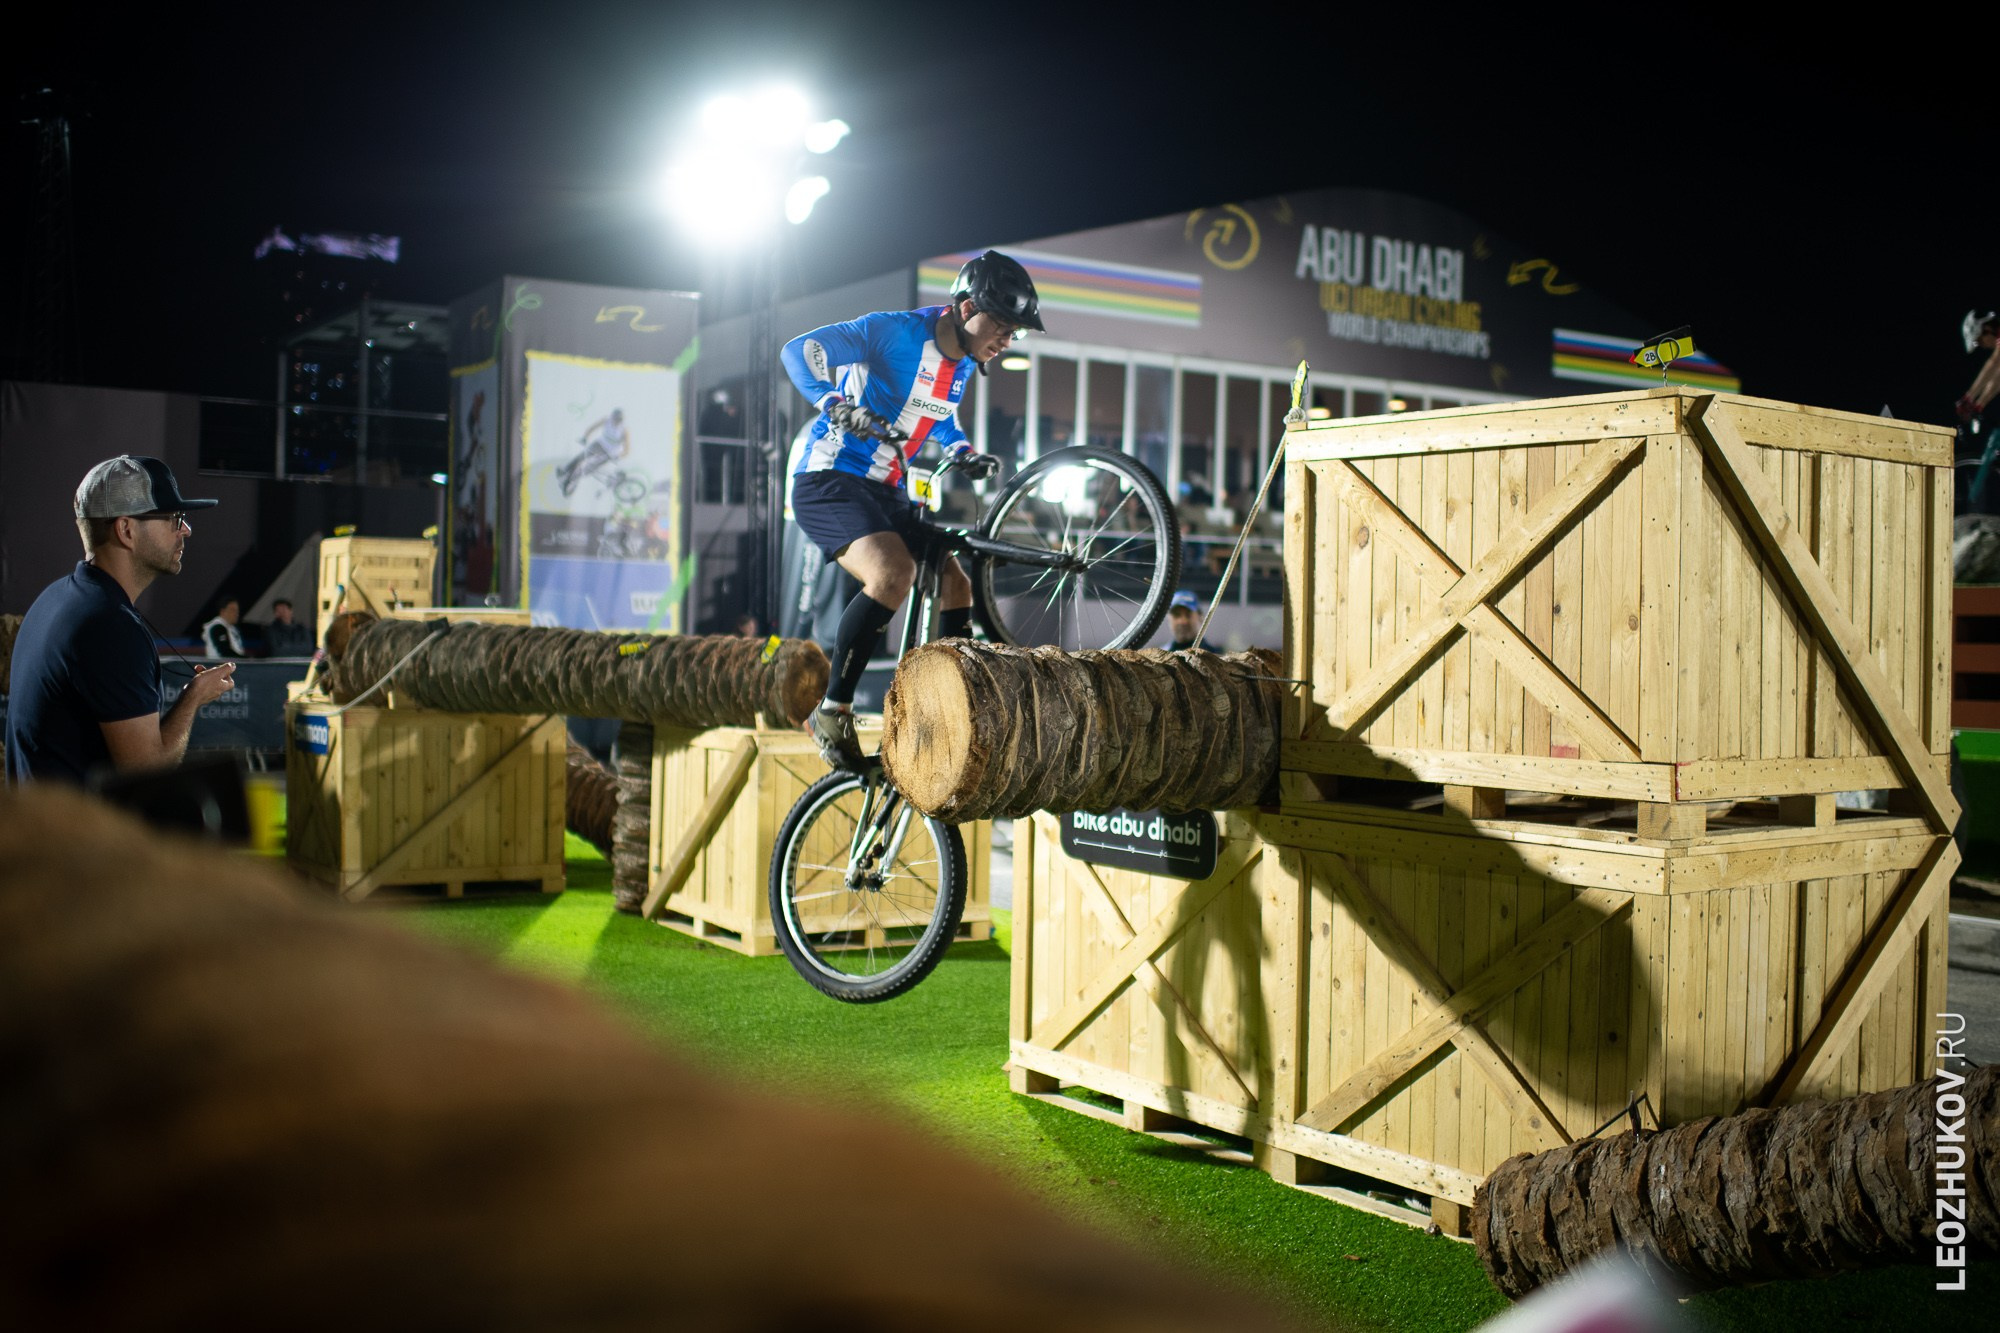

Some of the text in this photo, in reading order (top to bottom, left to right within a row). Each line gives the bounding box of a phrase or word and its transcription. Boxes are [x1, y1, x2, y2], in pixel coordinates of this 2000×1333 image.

[1296, 224, 1464, 303] ABU DHABI
[199, 704, 249, 720] Council
[1073, 811, 1201, 846] bike abu dhabi
